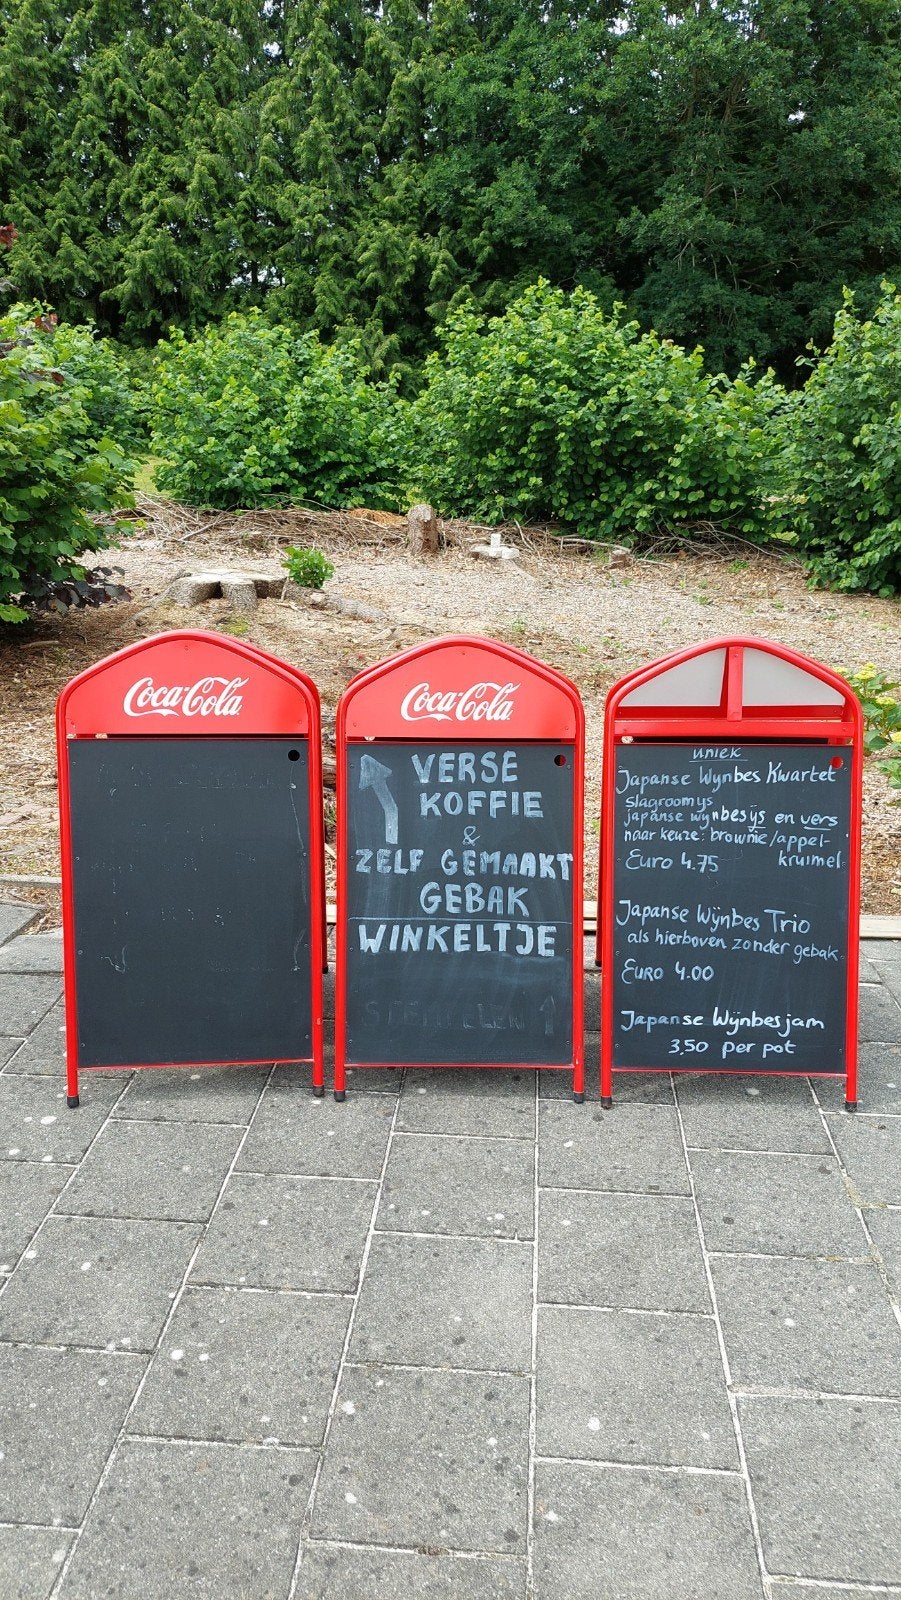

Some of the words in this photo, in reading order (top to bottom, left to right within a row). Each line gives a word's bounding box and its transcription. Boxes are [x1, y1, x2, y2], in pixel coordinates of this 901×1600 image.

[123, 676, 249, 717] Coca-Cola
[400, 682, 521, 721] Coca-Cola
[411, 751, 518, 784] VERSE
[616, 770, 691, 794] Japanse
[766, 762, 837, 784] Kwartet
[419, 790, 544, 818] KOFFIE
[624, 809, 684, 828] japanse
[774, 813, 795, 824] en
[801, 814, 839, 828] vers
[462, 825, 481, 847] &
[624, 829, 656, 842] naar
[355, 848, 424, 874] ZELF
[441, 848, 574, 880] GEMAAKT
[625, 848, 673, 870] Euro
[681, 851, 719, 874] 4.75
[420, 881, 529, 917] GEBAK
[616, 900, 688, 926] Japanse
[764, 909, 811, 934] Trio
[358, 923, 557, 957] WINKELTJE
[628, 929, 649, 944] als
[655, 930, 727, 950] hierboven
[731, 938, 790, 955] zonder
[675, 961, 715, 982] 4.00
[620, 1010, 703, 1033] Japanse
[722, 1041, 756, 1059] per
[762, 1039, 797, 1059] pot
